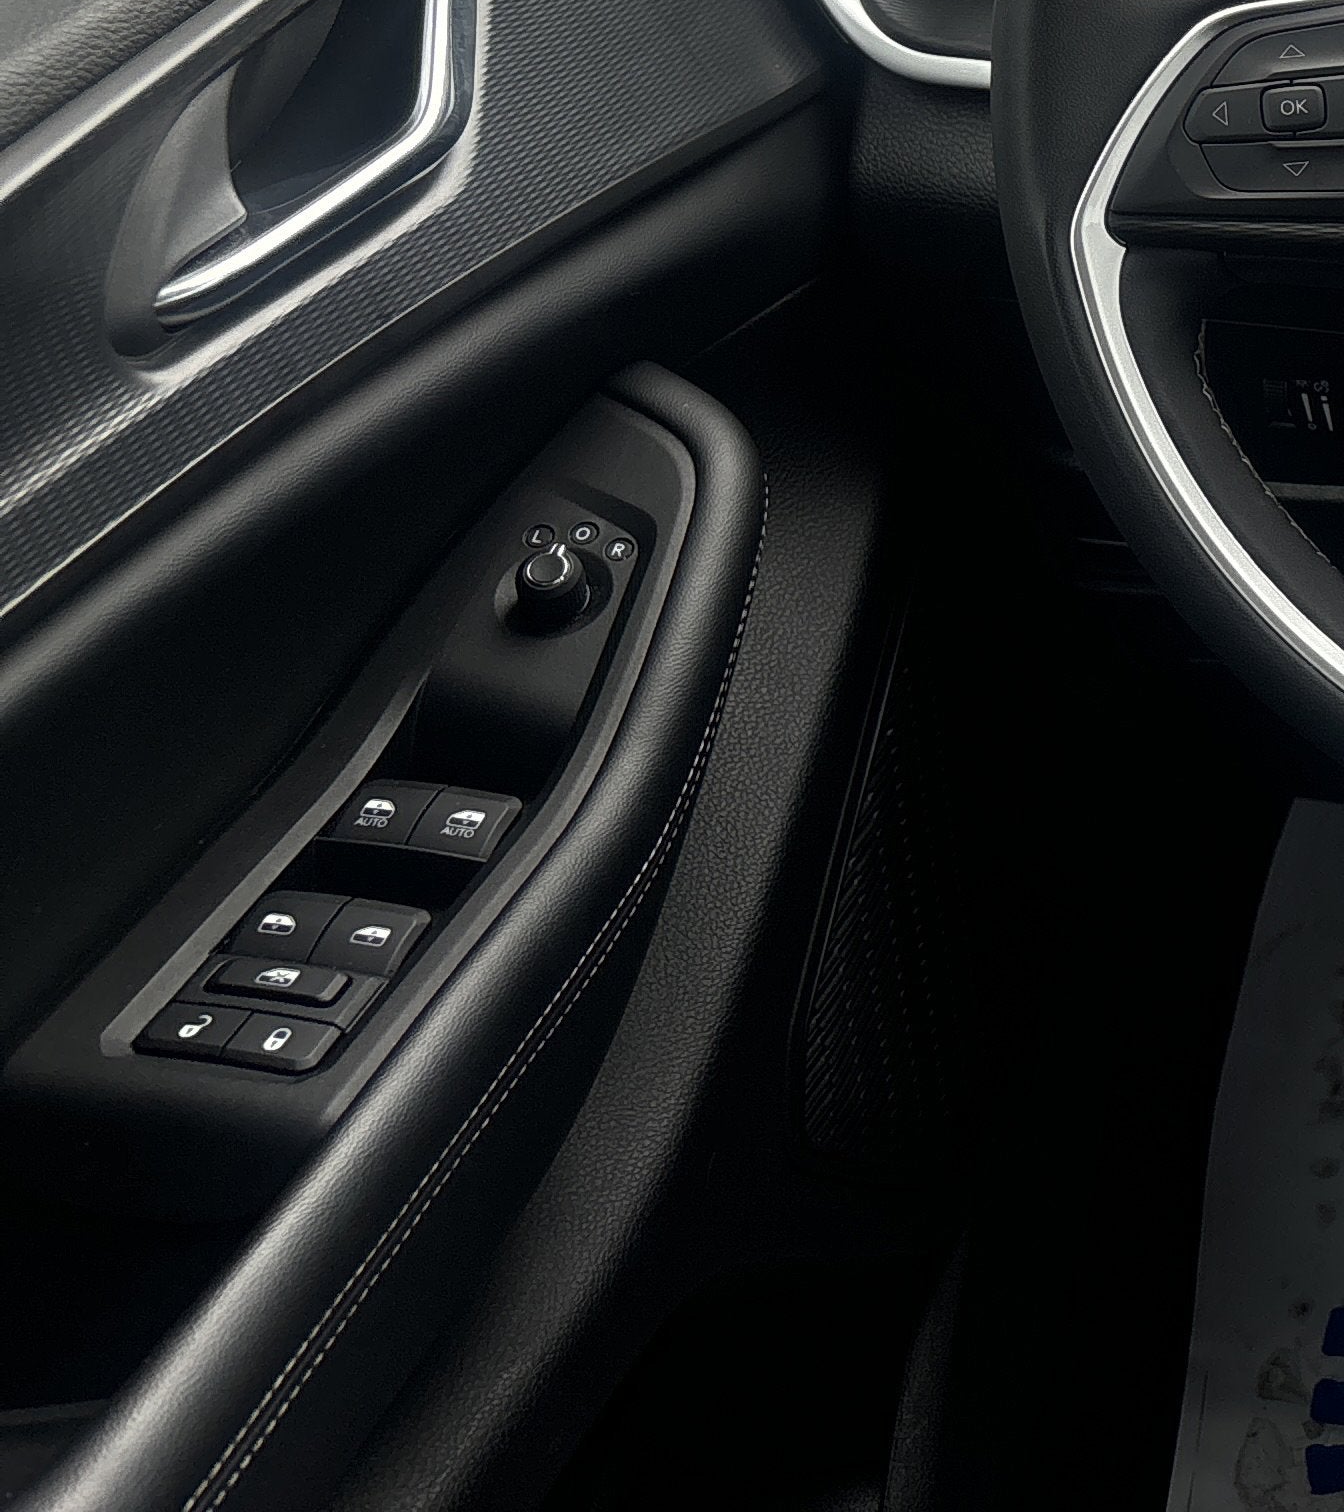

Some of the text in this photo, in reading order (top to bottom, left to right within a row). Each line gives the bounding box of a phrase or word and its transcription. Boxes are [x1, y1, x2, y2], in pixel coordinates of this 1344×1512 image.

[1280, 99, 1308, 116] OK
[531, 529, 542, 543] L
[611, 541, 625, 557] R
[355, 816, 388, 829] AUTO
[441, 826, 475, 839] AUTO
